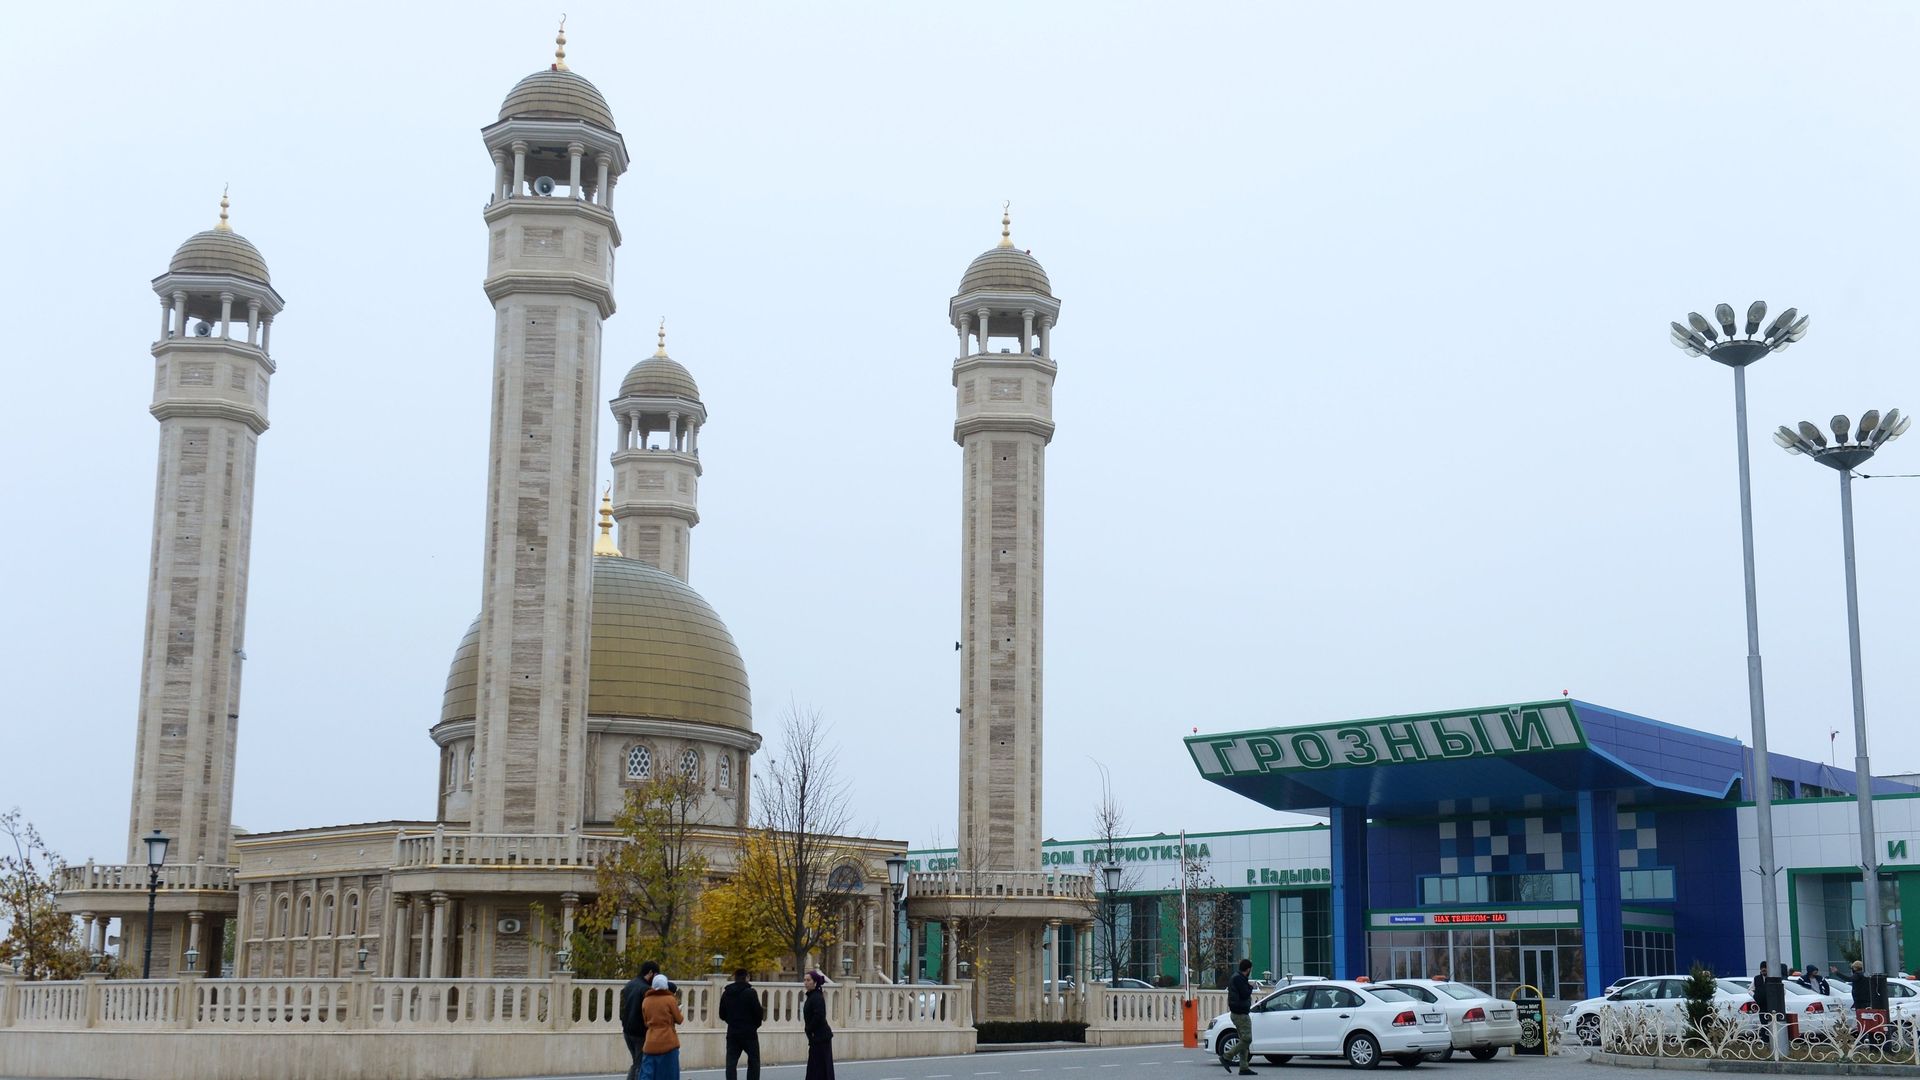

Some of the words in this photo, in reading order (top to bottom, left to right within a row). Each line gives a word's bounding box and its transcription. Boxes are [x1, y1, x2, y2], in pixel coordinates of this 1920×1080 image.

[1210, 706, 1554, 776] ГРОЗНЫЙ
[1083, 843, 1211, 864] ПАТРИОТИЗМА
[1888, 839, 1907, 859] И
[1260, 867, 1331, 885] Кадыров
